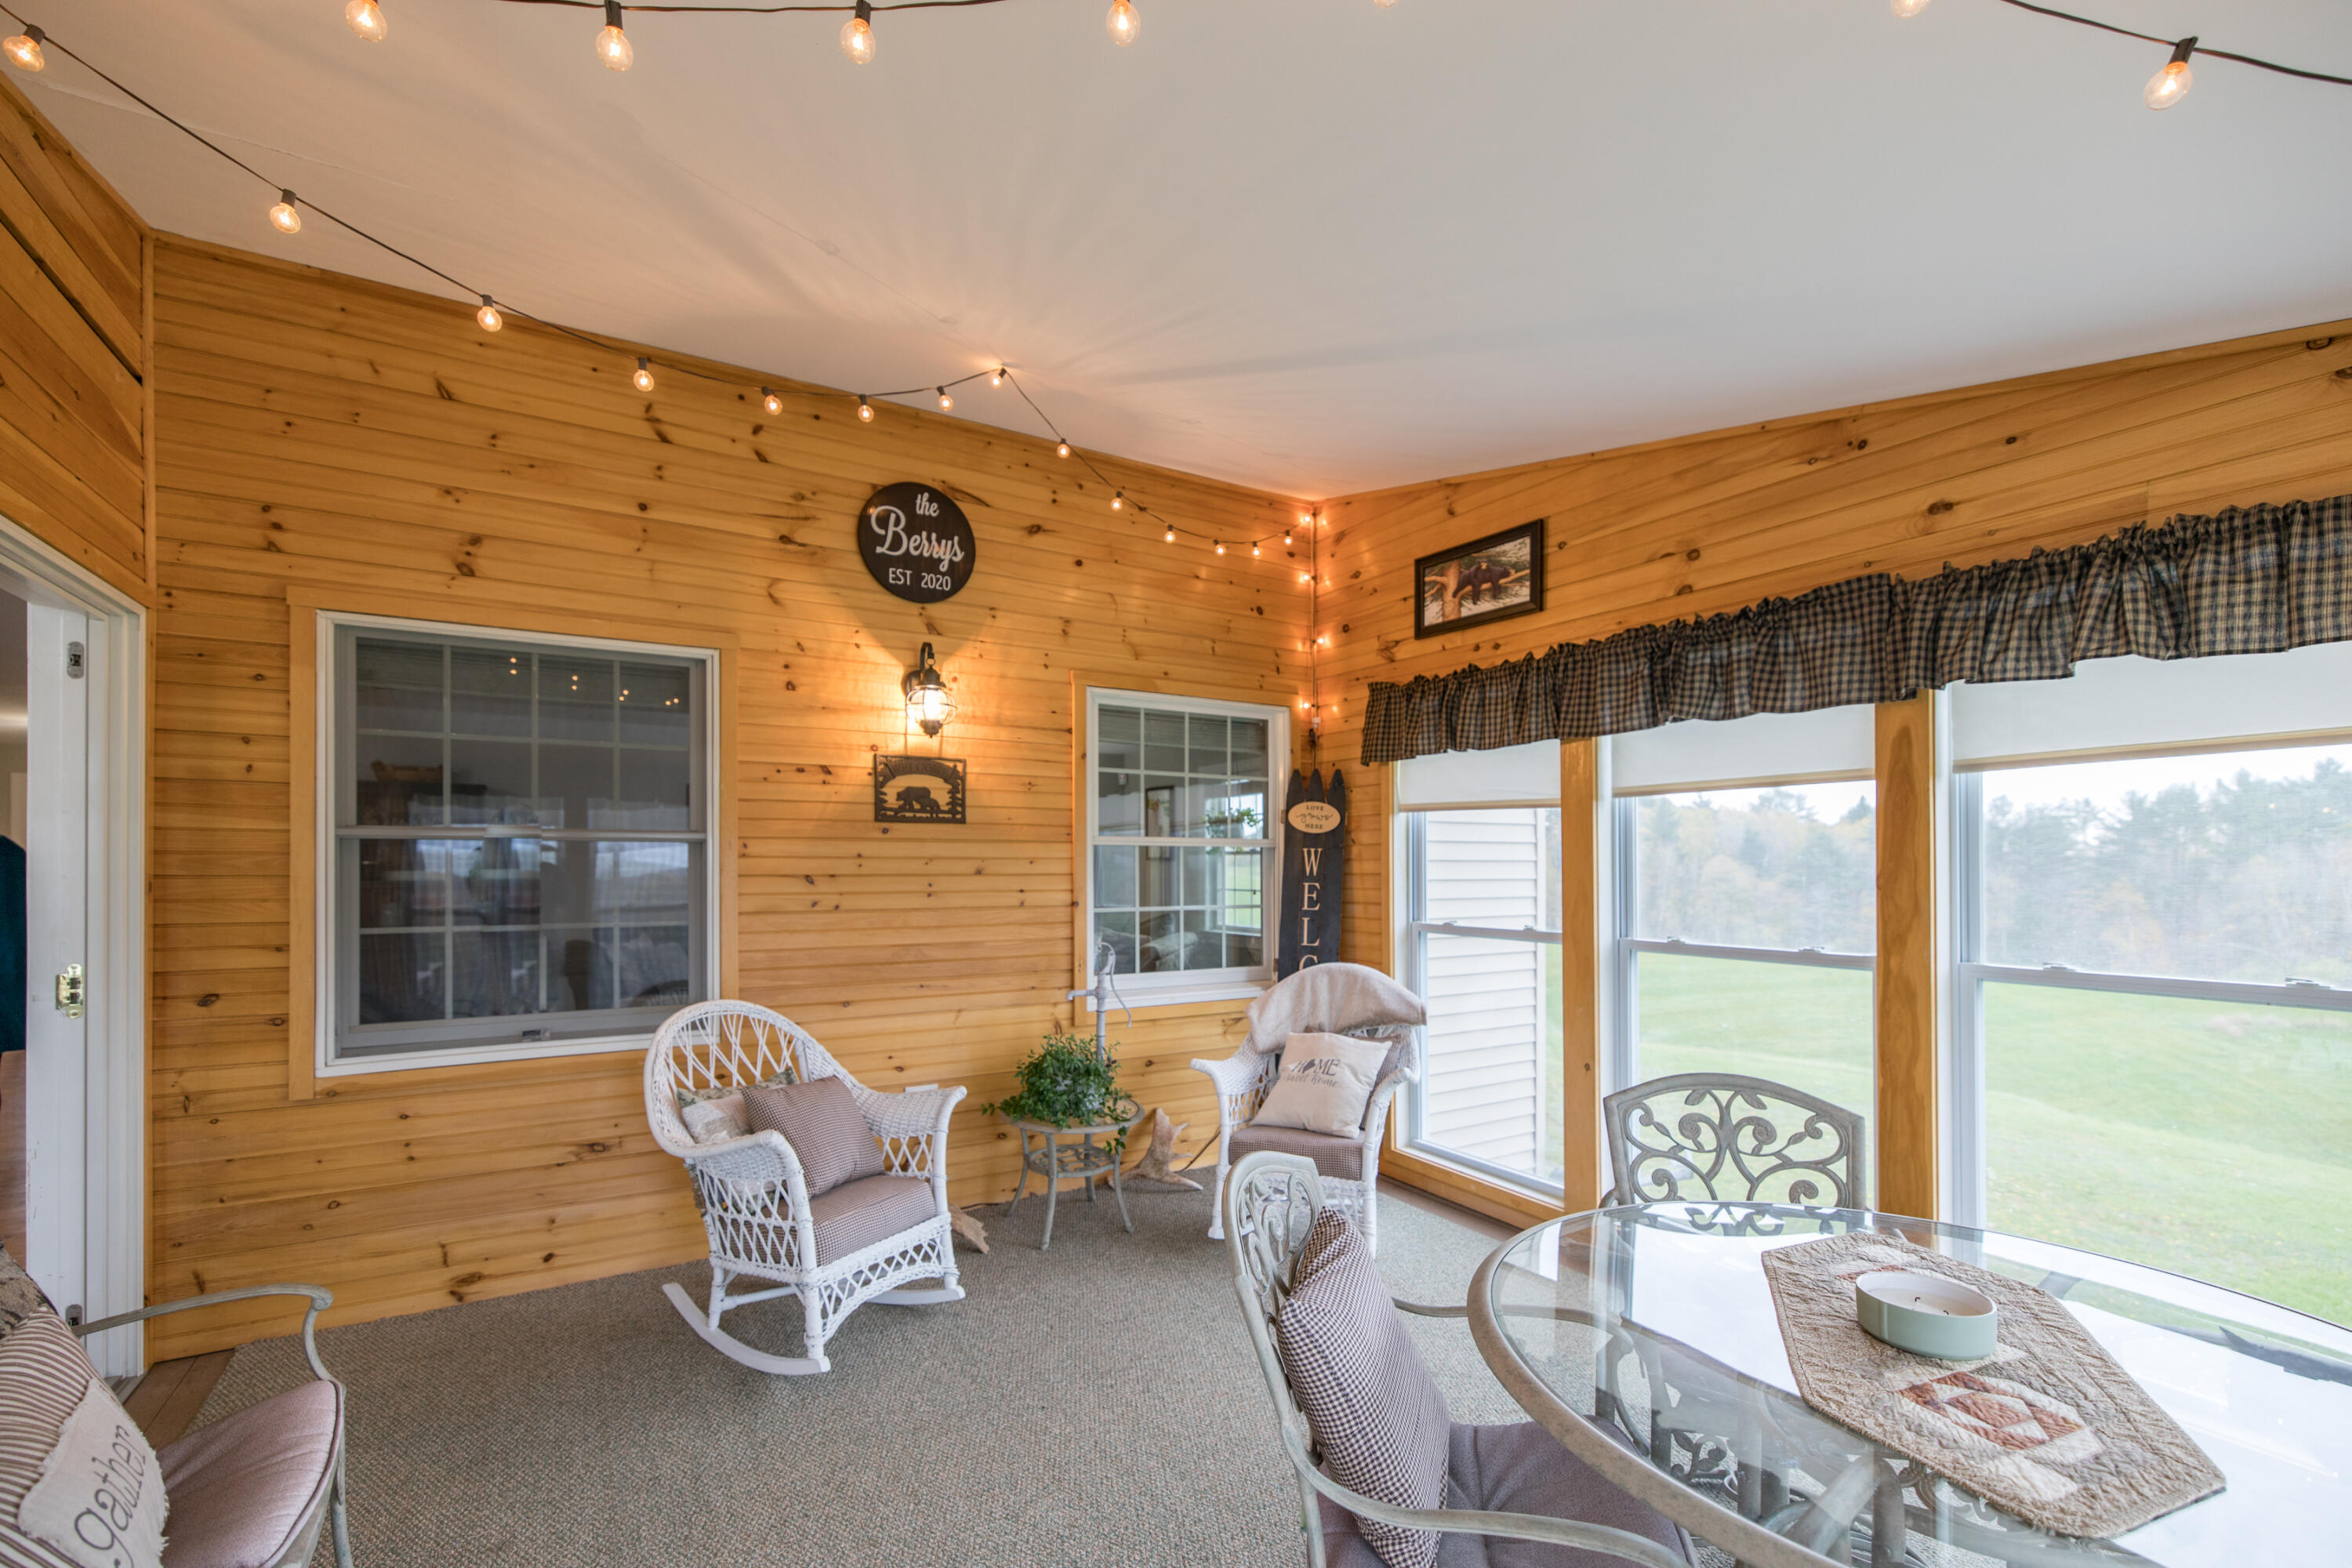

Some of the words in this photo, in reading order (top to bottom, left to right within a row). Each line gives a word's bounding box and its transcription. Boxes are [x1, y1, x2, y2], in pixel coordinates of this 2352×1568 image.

[915, 492, 940, 517] the
[870, 504, 965, 572] Berrys
[888, 567, 913, 586] EST
[920, 572, 952, 591] 2020
[1290, 1058, 1341, 1076] HME
[74, 1424, 147, 1568] gather
